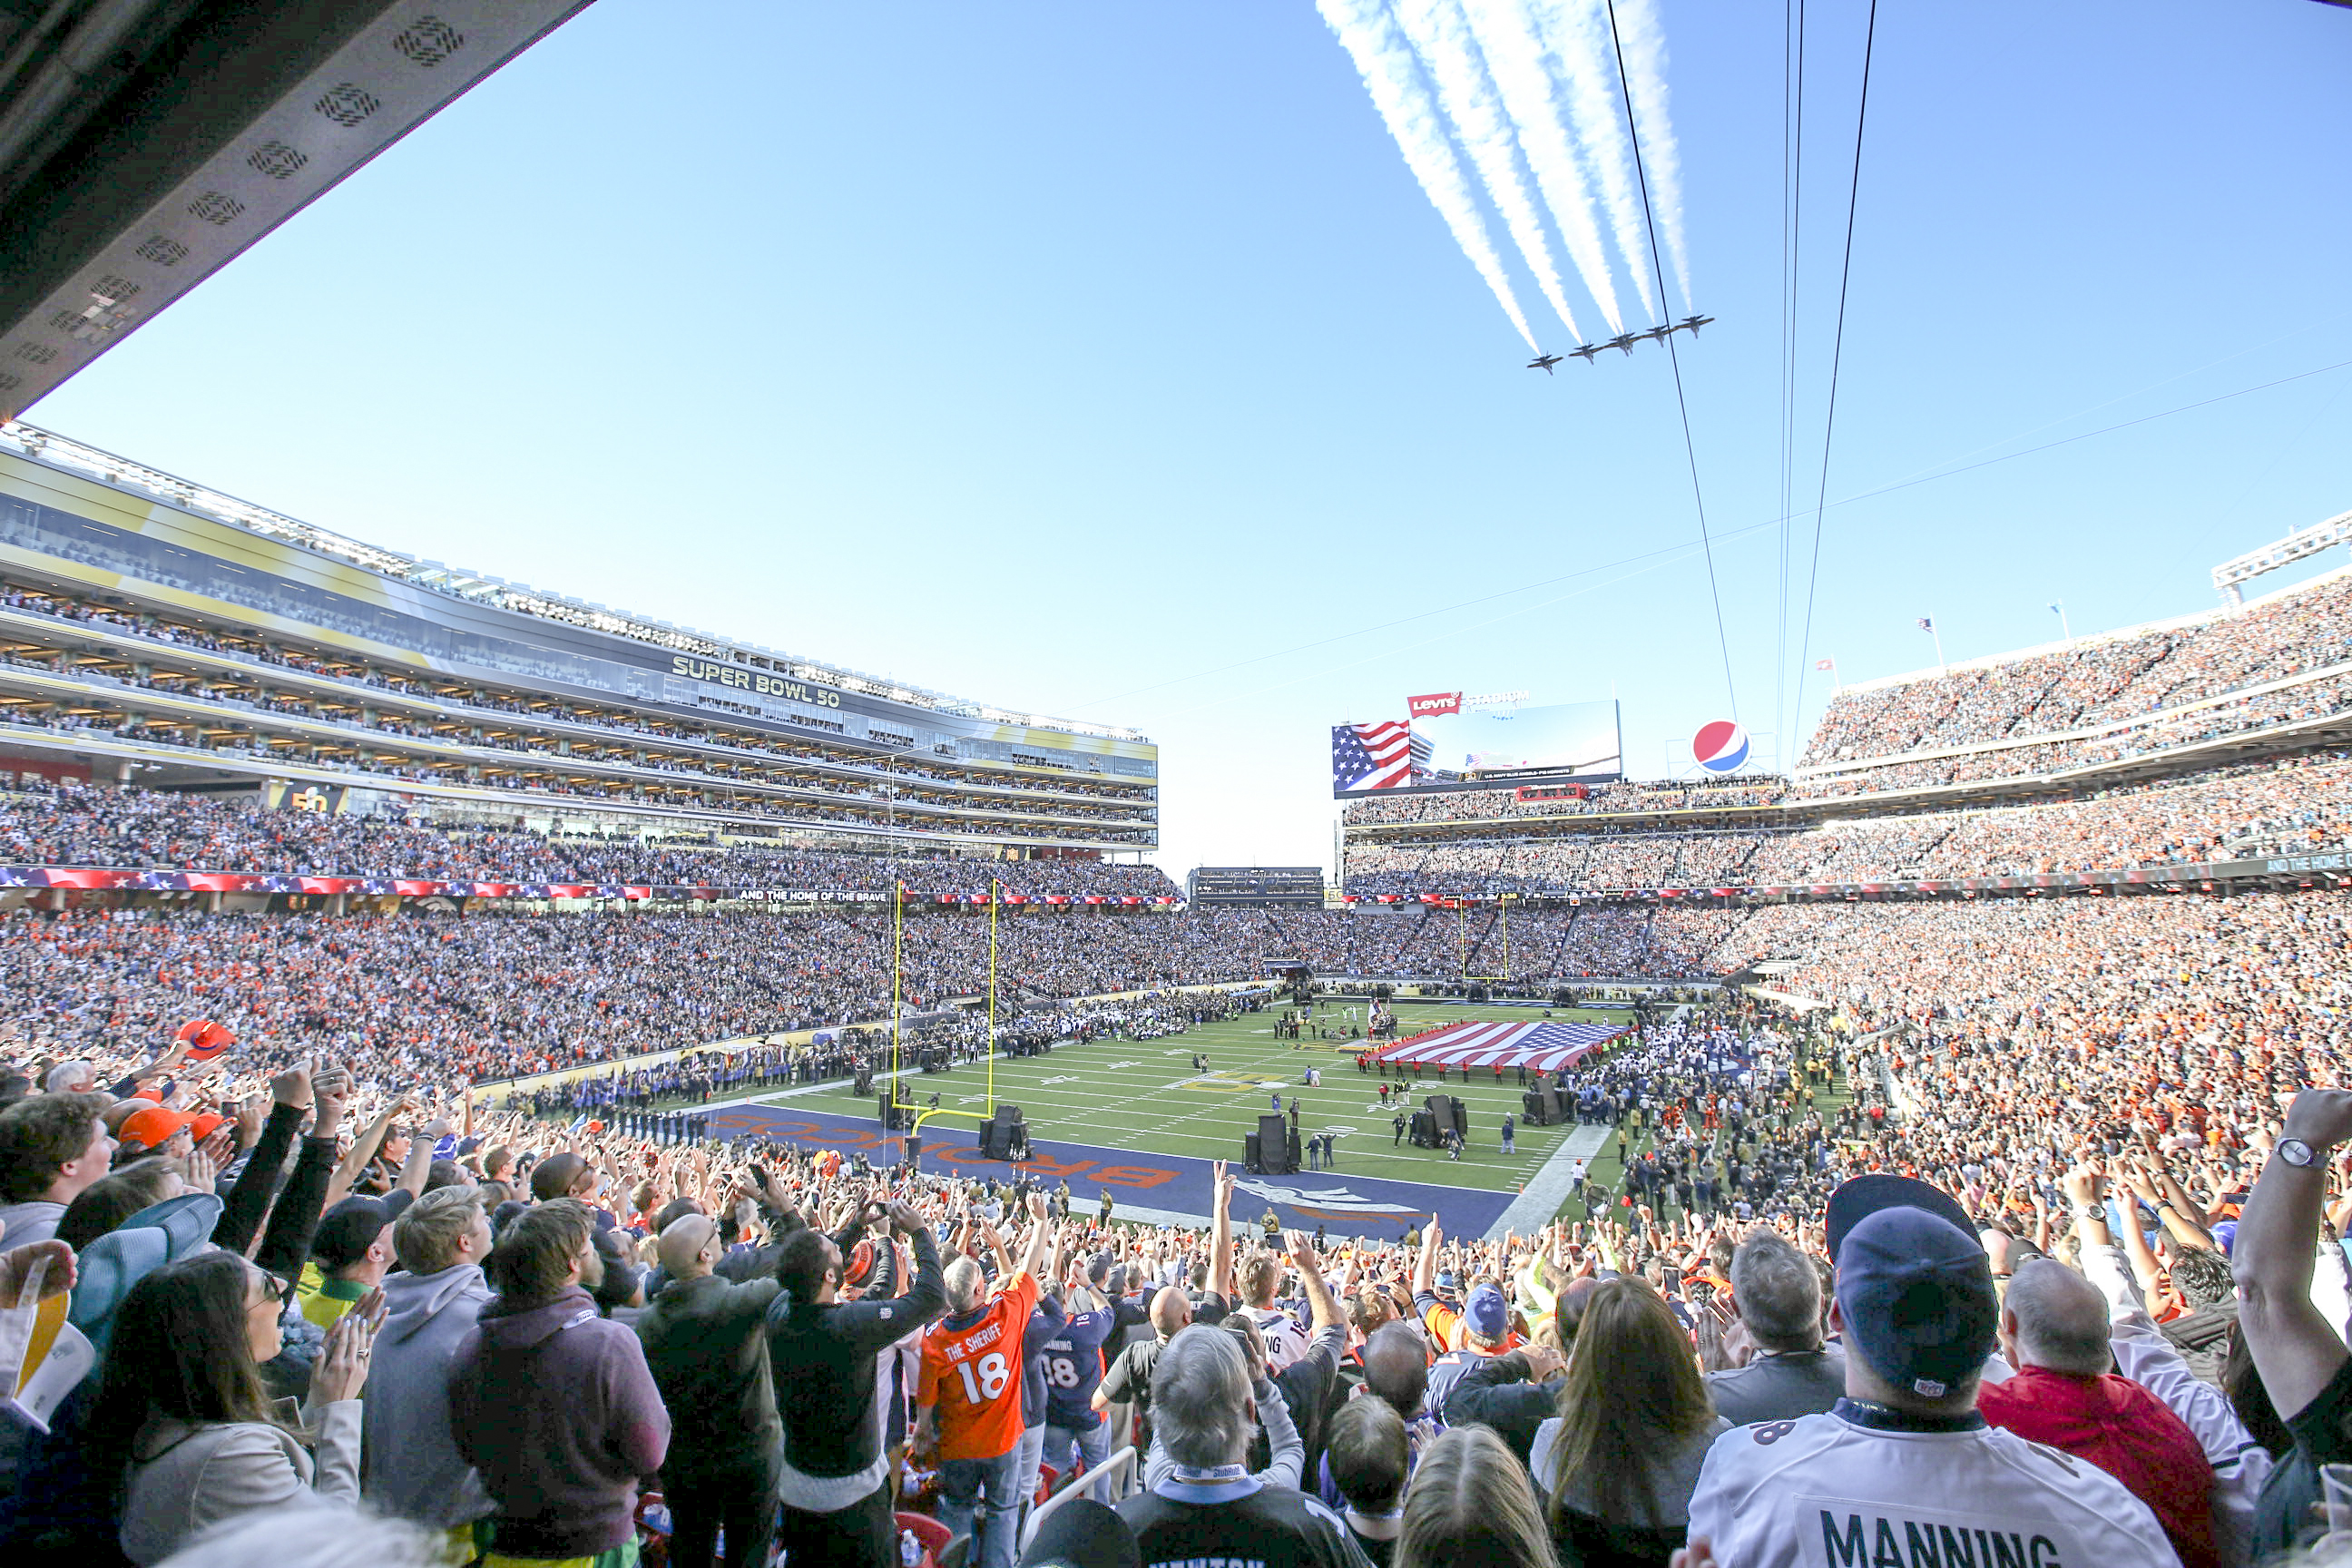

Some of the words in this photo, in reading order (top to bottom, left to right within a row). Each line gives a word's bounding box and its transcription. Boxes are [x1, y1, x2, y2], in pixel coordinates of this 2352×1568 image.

[672, 656, 750, 690] SUPER
[756, 675, 812, 703] BOWL
[817, 690, 840, 709] 50
[1465, 690, 1531, 706] STADIUM
[2267, 858, 2288, 872] AND
[2288, 857, 2310, 871] THE
[2311, 854, 2345, 869] HOME
[740, 890, 764, 900] AND
[767, 890, 788, 900] THE
[789, 891, 818, 901] HOME
[820, 892, 834, 901] OF
[836, 892, 855, 901] THE
[856, 892, 887, 902] BRAVE
[1289, 1320, 1306, 1338] 18
[945, 1342, 964, 1362] THE
[965, 1322, 1003, 1354] SHERIFF
[1044, 1340, 1073, 1351] ANNING
[957, 1352, 1010, 1405] 18
[1213, 1465, 1240, 1478] StubHub!
[1819, 1510, 2058, 1568] MANNING
